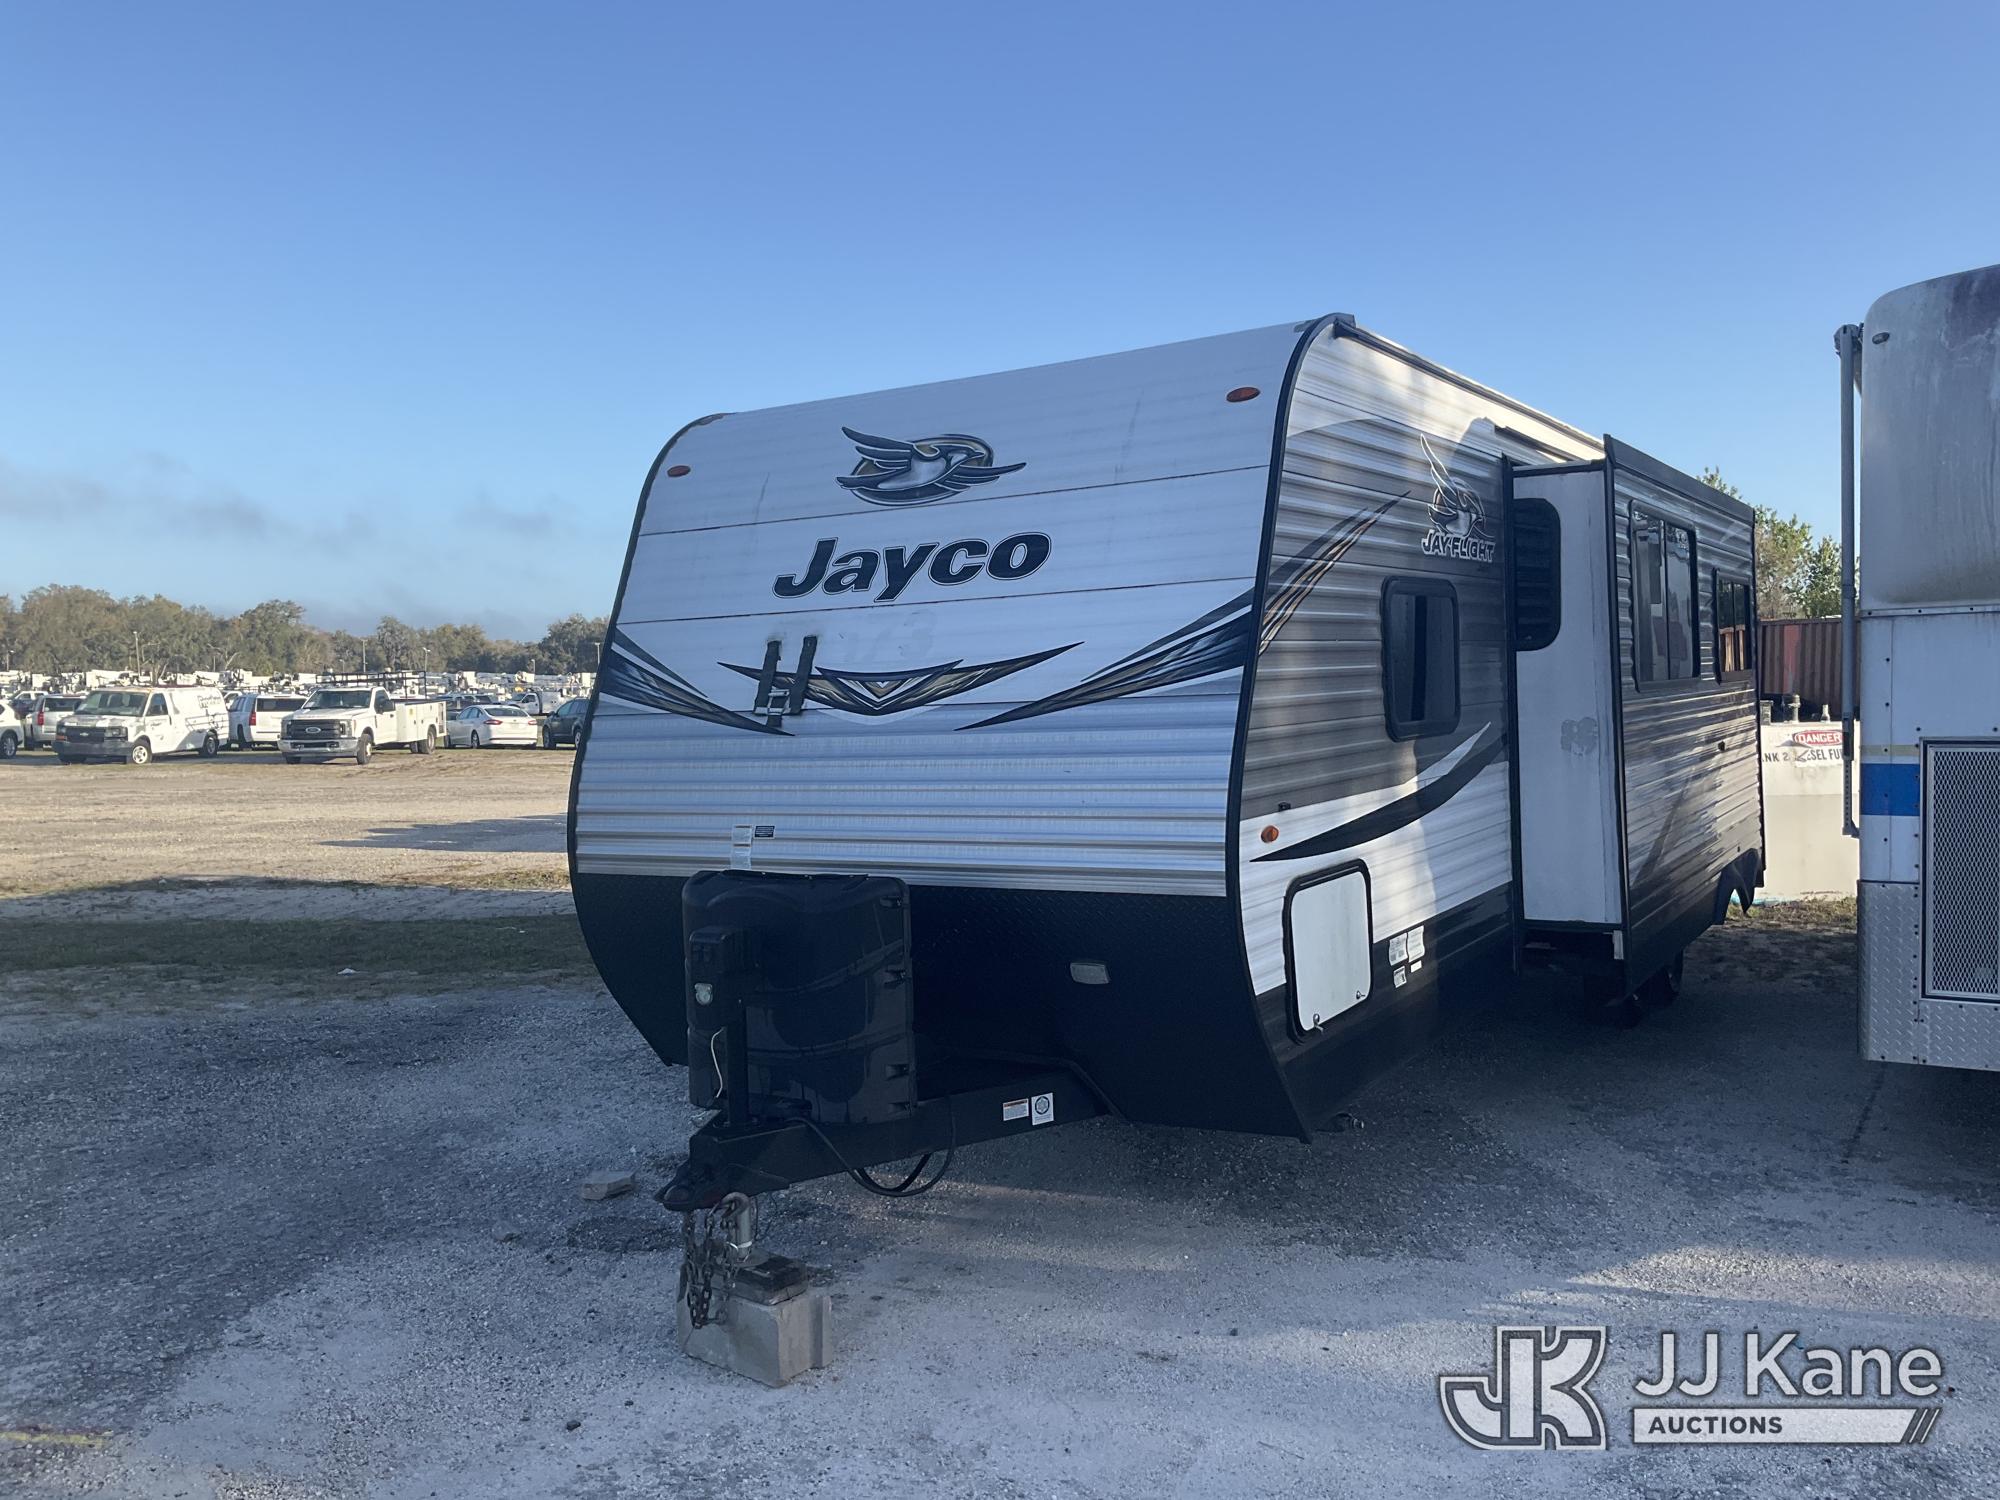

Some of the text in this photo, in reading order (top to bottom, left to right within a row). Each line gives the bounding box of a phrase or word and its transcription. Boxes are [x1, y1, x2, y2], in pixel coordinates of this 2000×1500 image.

[772, 531, 1052, 603] Jayco
[1797, 733, 1841, 743] DANGER
[1761, 752, 1780, 762] NK
